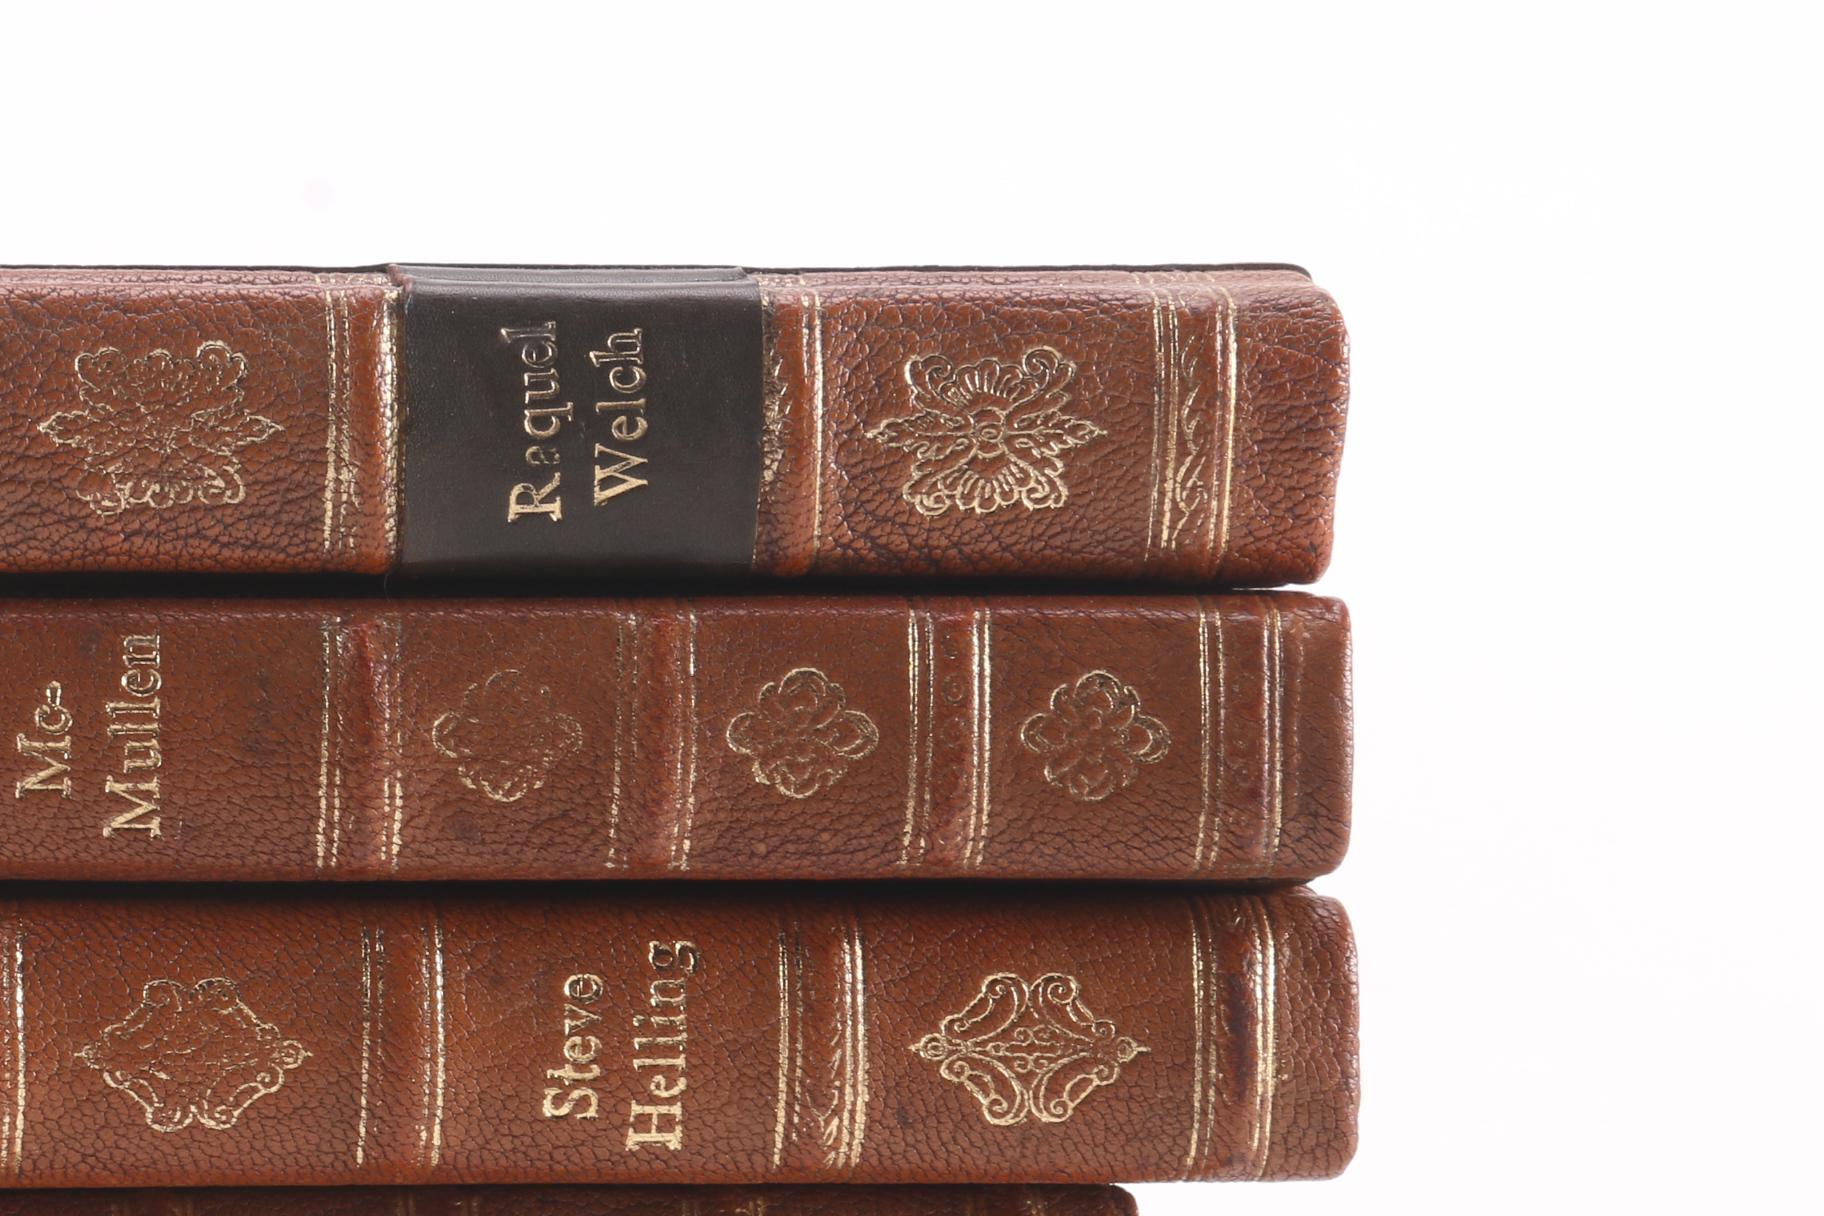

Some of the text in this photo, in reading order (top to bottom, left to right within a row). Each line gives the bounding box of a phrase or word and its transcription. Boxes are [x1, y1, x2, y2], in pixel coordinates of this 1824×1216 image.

[500, 321, 574, 523] Raquel
[589, 328, 648, 507] Welch
[102, 630, 161, 841] Mullen
[542, 973, 604, 1120] Steve
[625, 940, 700, 1151] Helling
